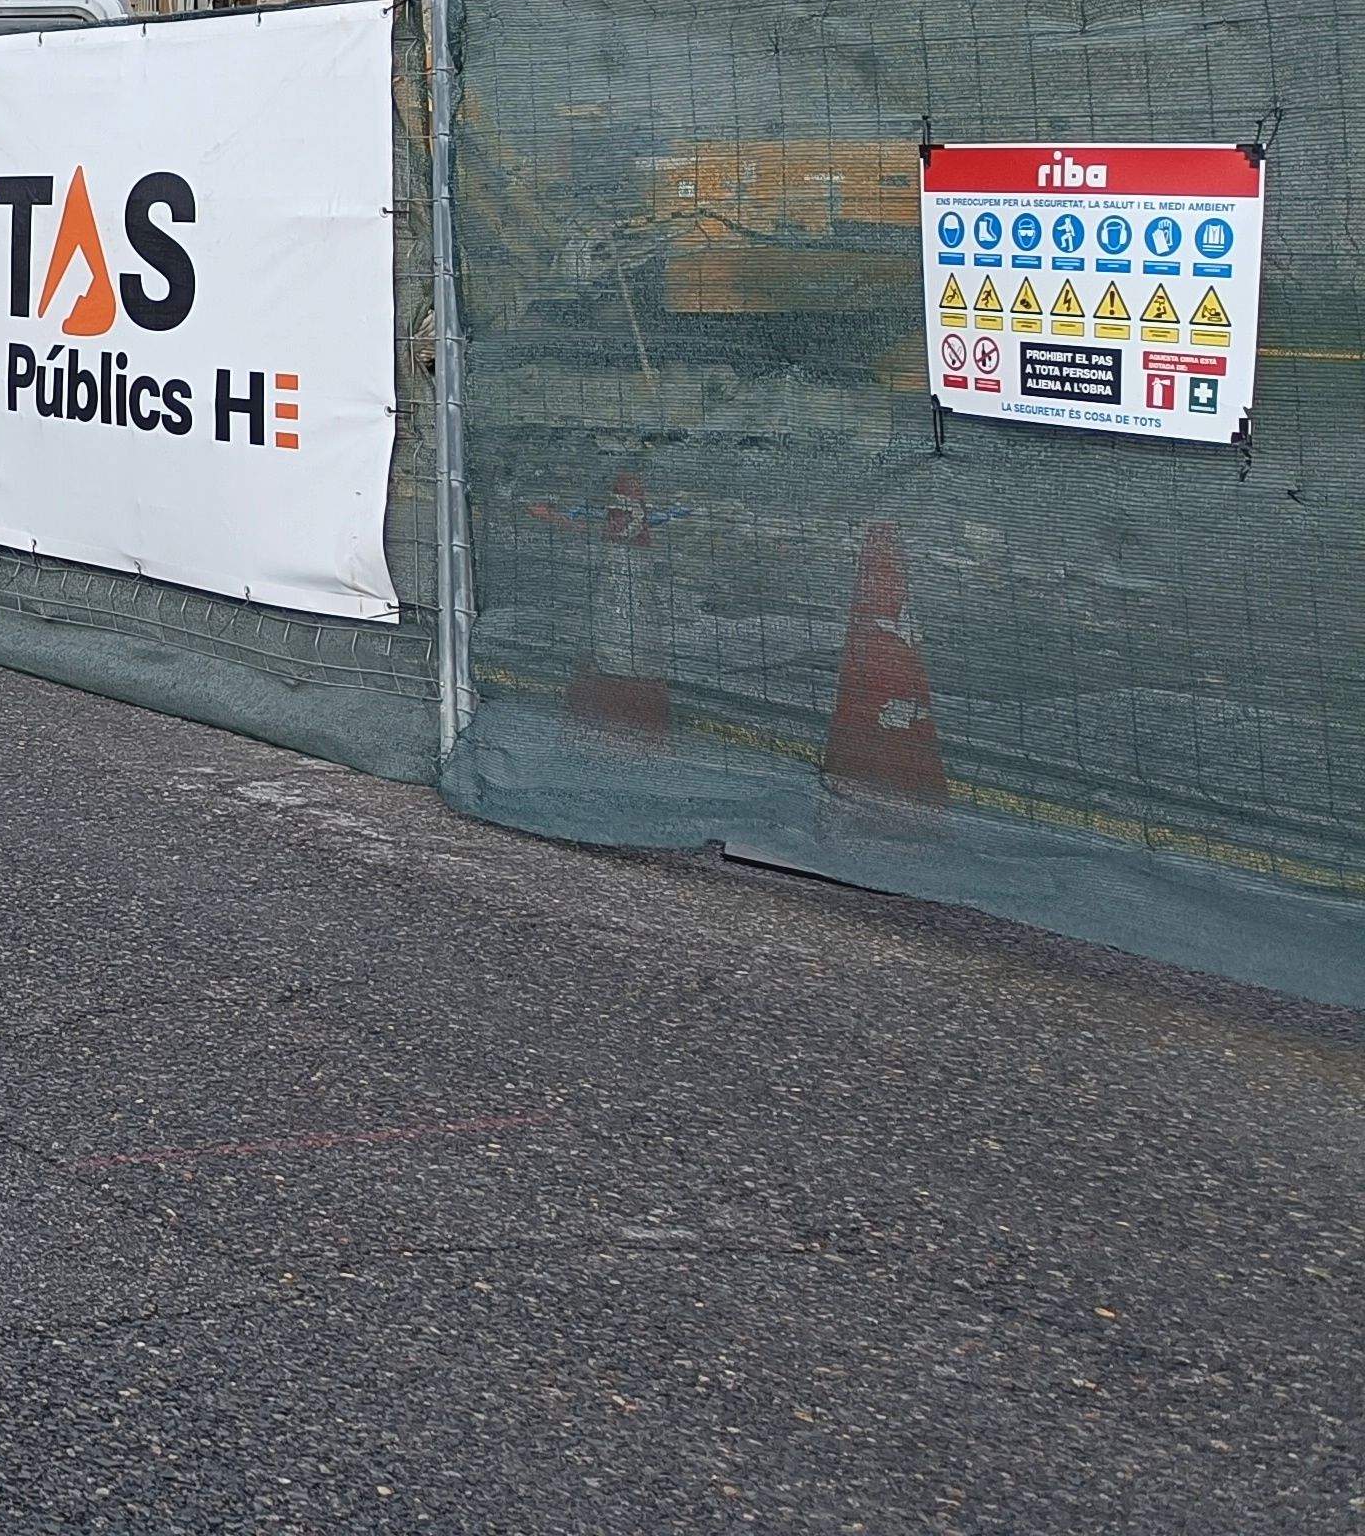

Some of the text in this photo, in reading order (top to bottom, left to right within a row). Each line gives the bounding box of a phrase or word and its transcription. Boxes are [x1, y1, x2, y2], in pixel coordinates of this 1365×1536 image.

[1038, 150, 1107, 188] riba
[936, 197, 950, 206] ENS
[953, 197, 1000, 207] PREOCUPEM
[1003, 198, 1018, 207] PER
[1021, 199, 1031, 207] LA
[1033, 199, 1086, 209] SEGURETAT,
[1088, 200, 1100, 208] LA
[1103, 201, 1133, 209] SALUT
[1143, 202, 1155, 210] EL
[1159, 202, 1185, 211] MEDI
[1188, 203, 1236, 212] AMBIENT
[1026, 349, 1113, 366] PROHIBIT EL PAS
[1025, 364, 1113, 381] A TOTA PERSONA
[7, 341, 193, 437] Públics
[1026, 378, 1112, 396] ALIENA A L'OBRA
[1001, 402, 1162, 428] LA SEGURETAT ÉS COSA DE TOTS
